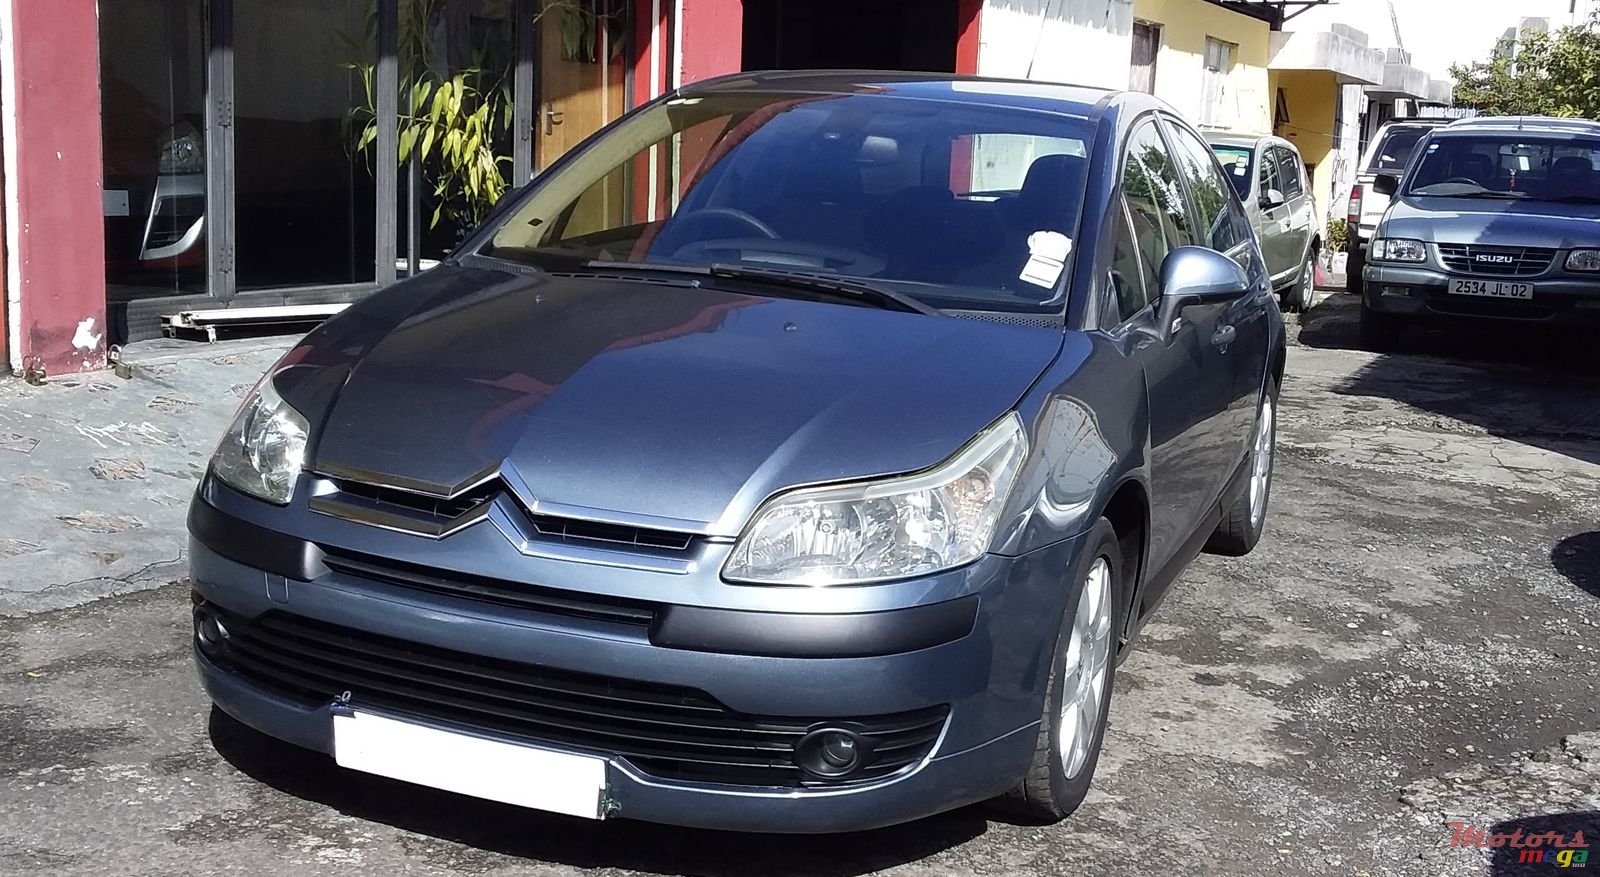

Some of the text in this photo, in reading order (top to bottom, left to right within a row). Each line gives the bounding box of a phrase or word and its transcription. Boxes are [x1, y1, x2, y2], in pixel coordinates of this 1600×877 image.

[1475, 254, 1513, 263] ISUZU
[1455, 280, 1527, 297] 2534 JL 02
